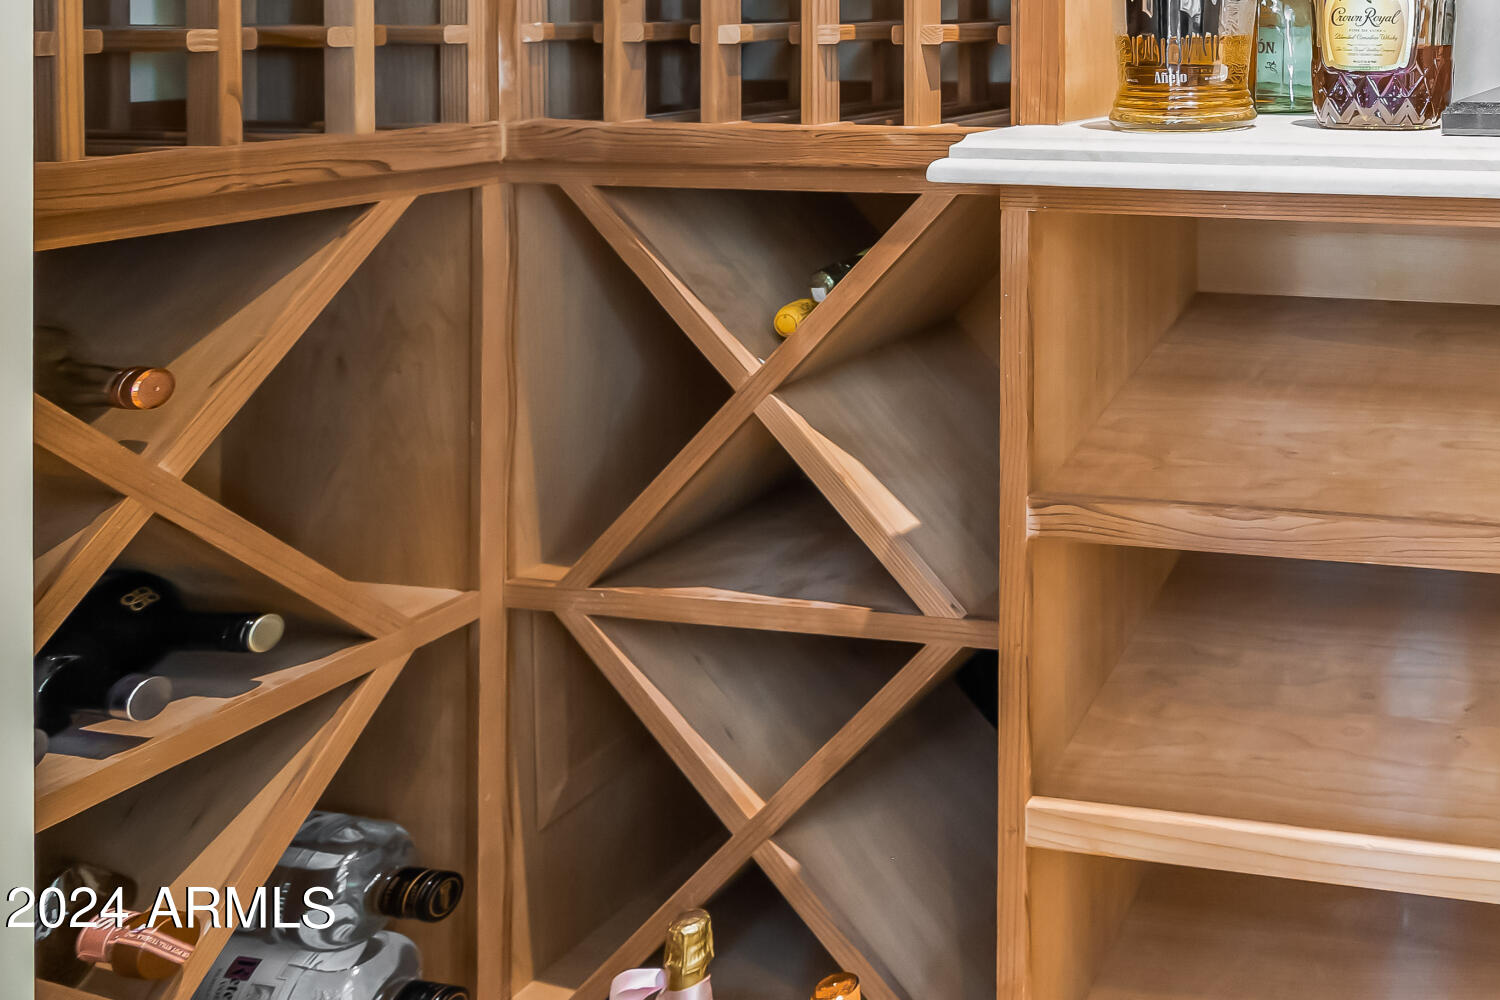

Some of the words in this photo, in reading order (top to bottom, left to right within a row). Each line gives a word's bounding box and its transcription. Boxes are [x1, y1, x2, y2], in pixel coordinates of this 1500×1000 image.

[1331, 6, 1362, 27] Crown
[1355, 6, 1401, 28] Royal
[1154, 71, 1188, 87] Añejo
